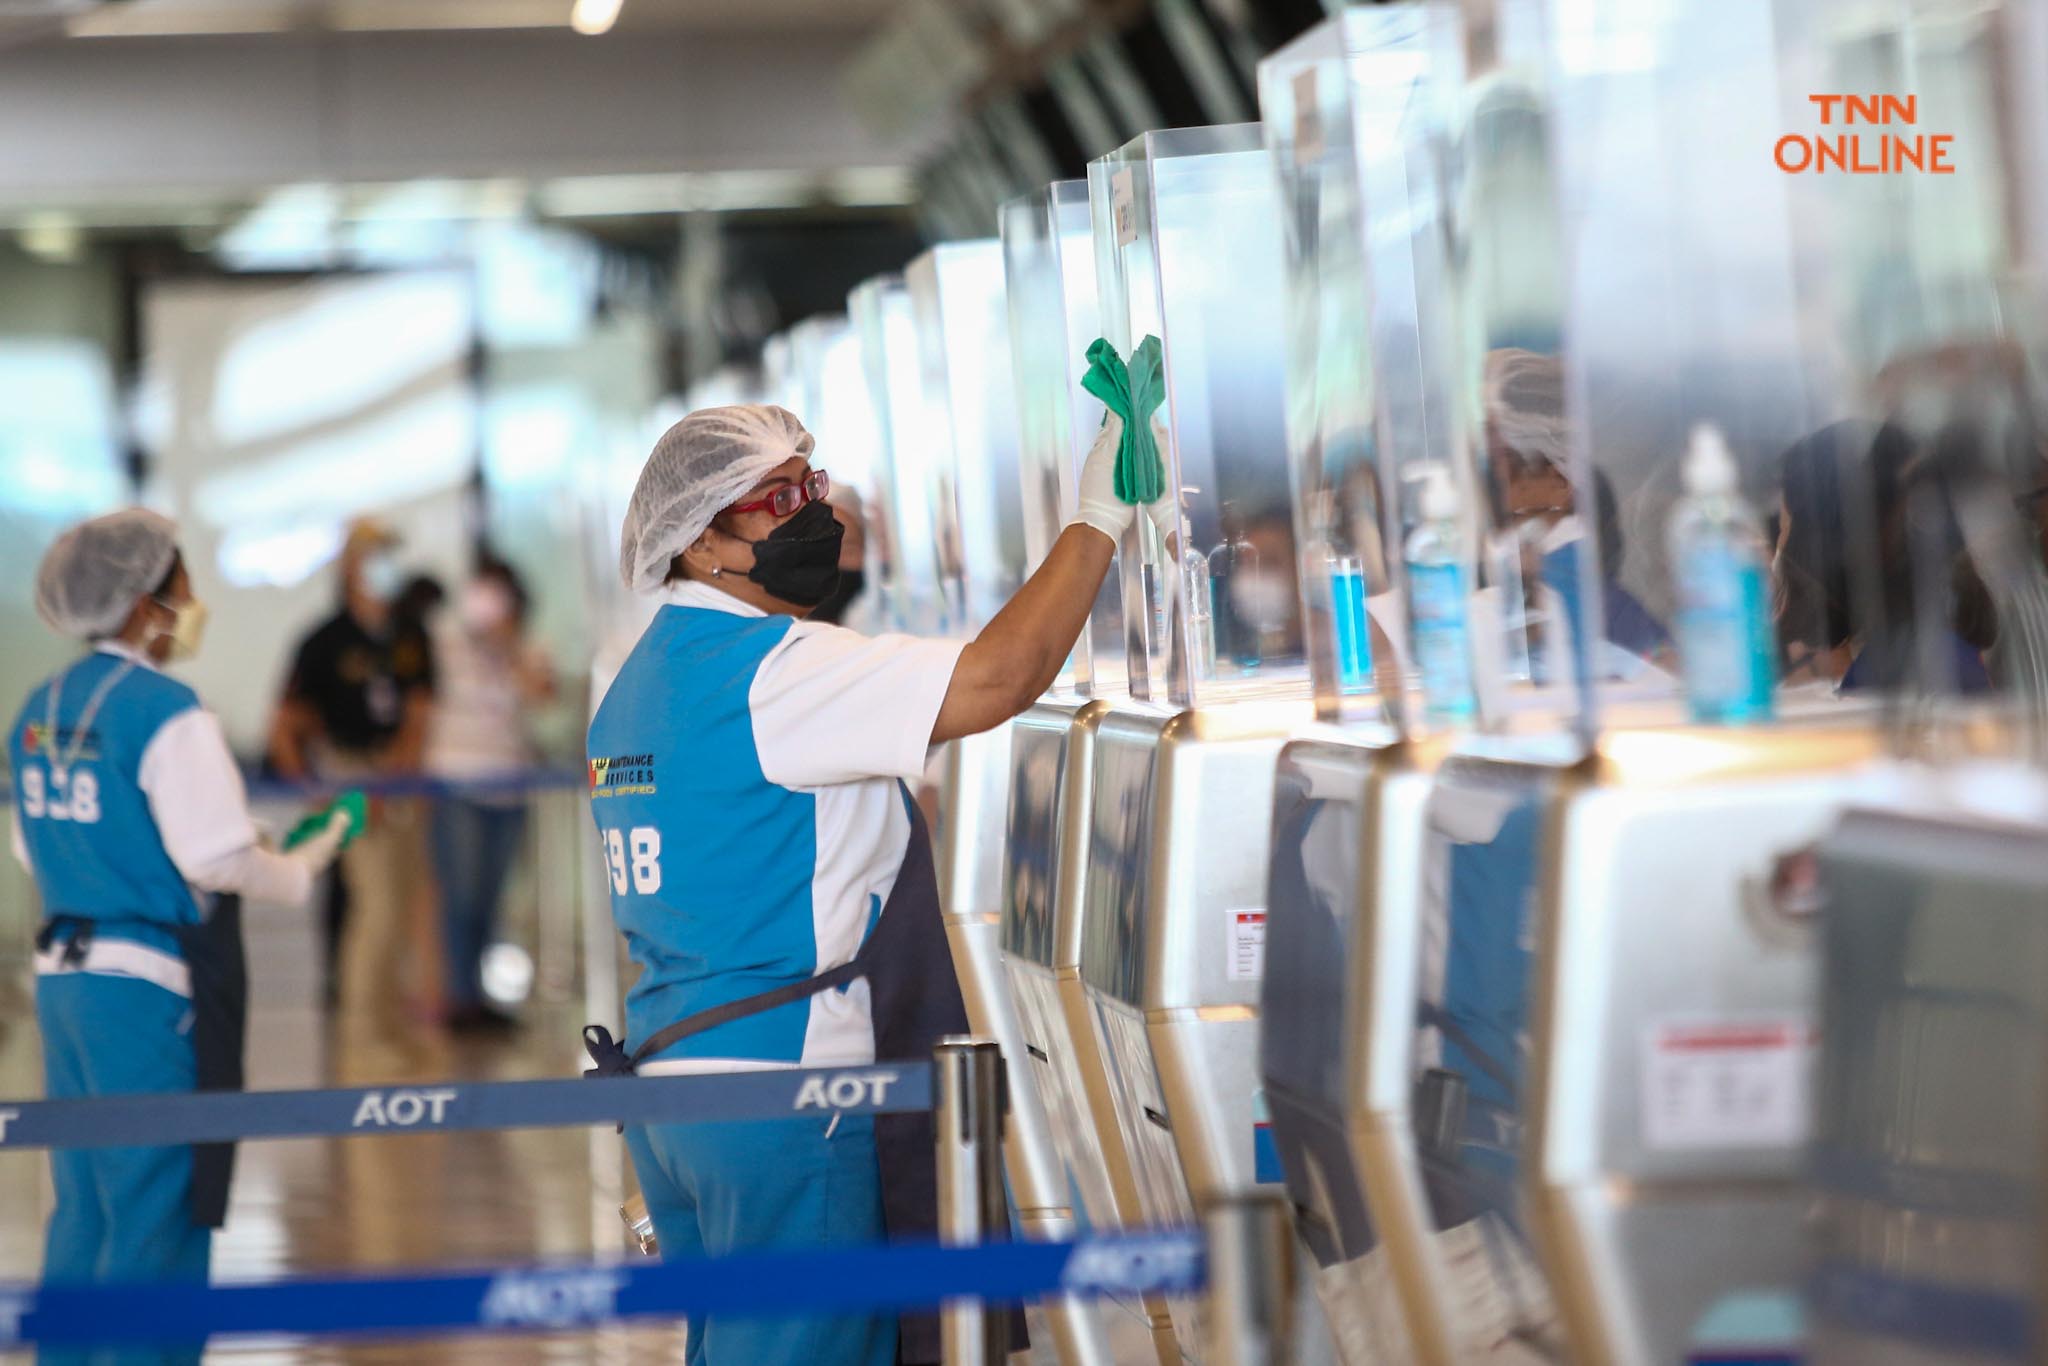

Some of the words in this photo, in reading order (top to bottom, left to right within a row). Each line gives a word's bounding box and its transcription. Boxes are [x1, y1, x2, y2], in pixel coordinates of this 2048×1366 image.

[602, 826, 661, 896] 98
[352, 1087, 458, 1128] AOT
[790, 1070, 899, 1110] AOT
